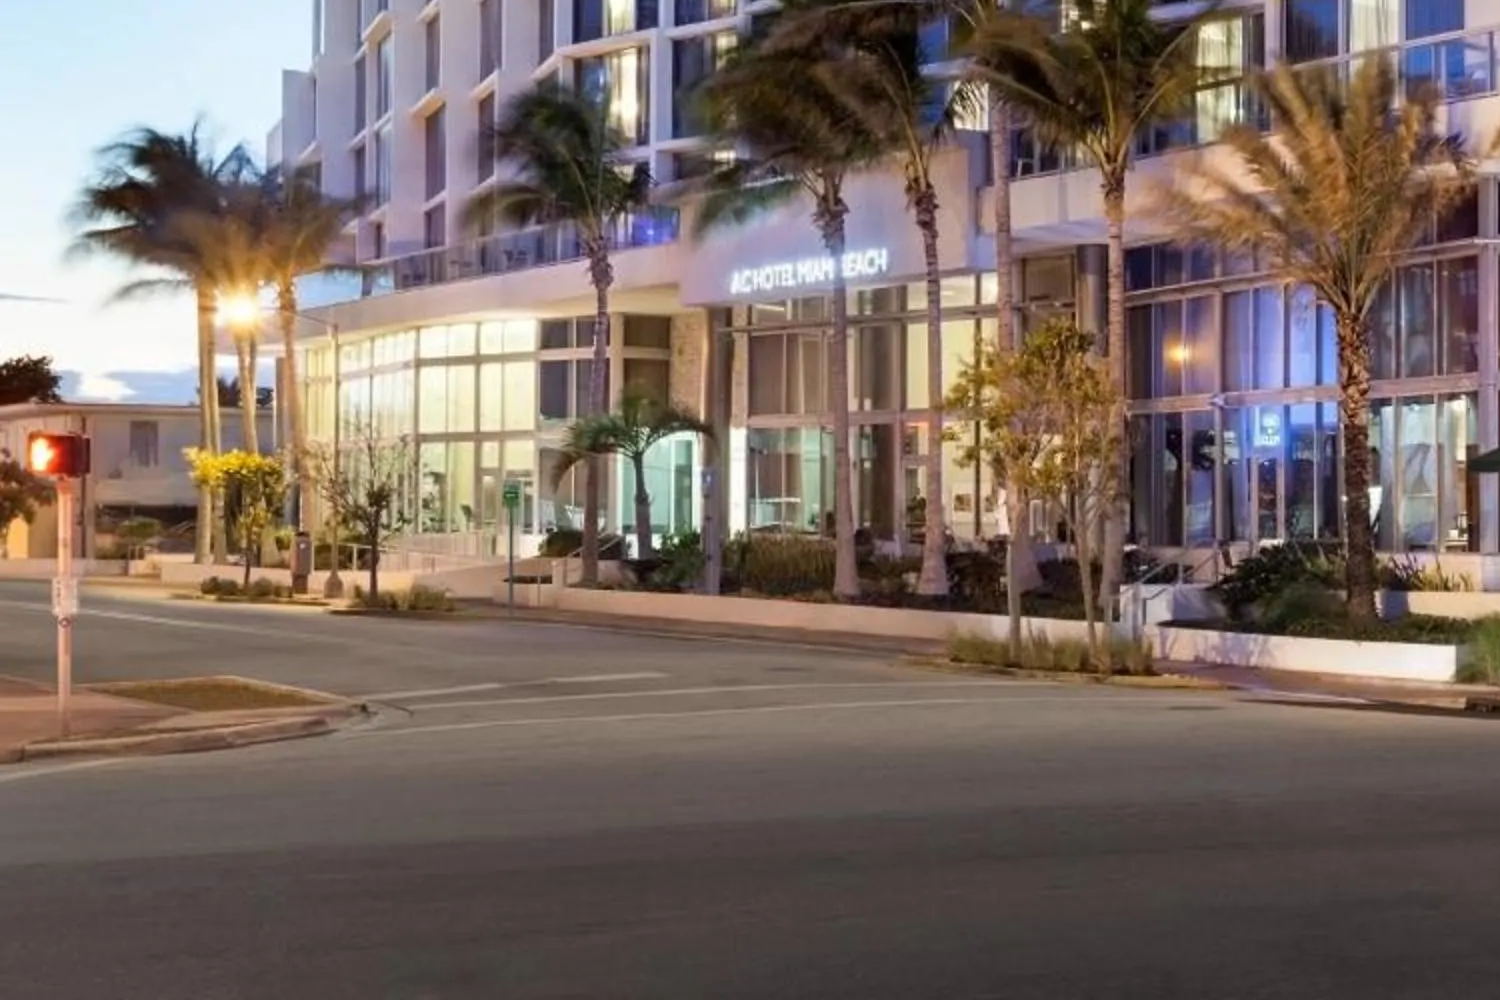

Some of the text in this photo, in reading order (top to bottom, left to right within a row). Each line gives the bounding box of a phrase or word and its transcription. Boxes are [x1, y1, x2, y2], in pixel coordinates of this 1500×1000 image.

[730, 271, 752, 294] AC
[753, 261, 796, 290] HOTEL
[797, 256, 834, 284] MIAM
